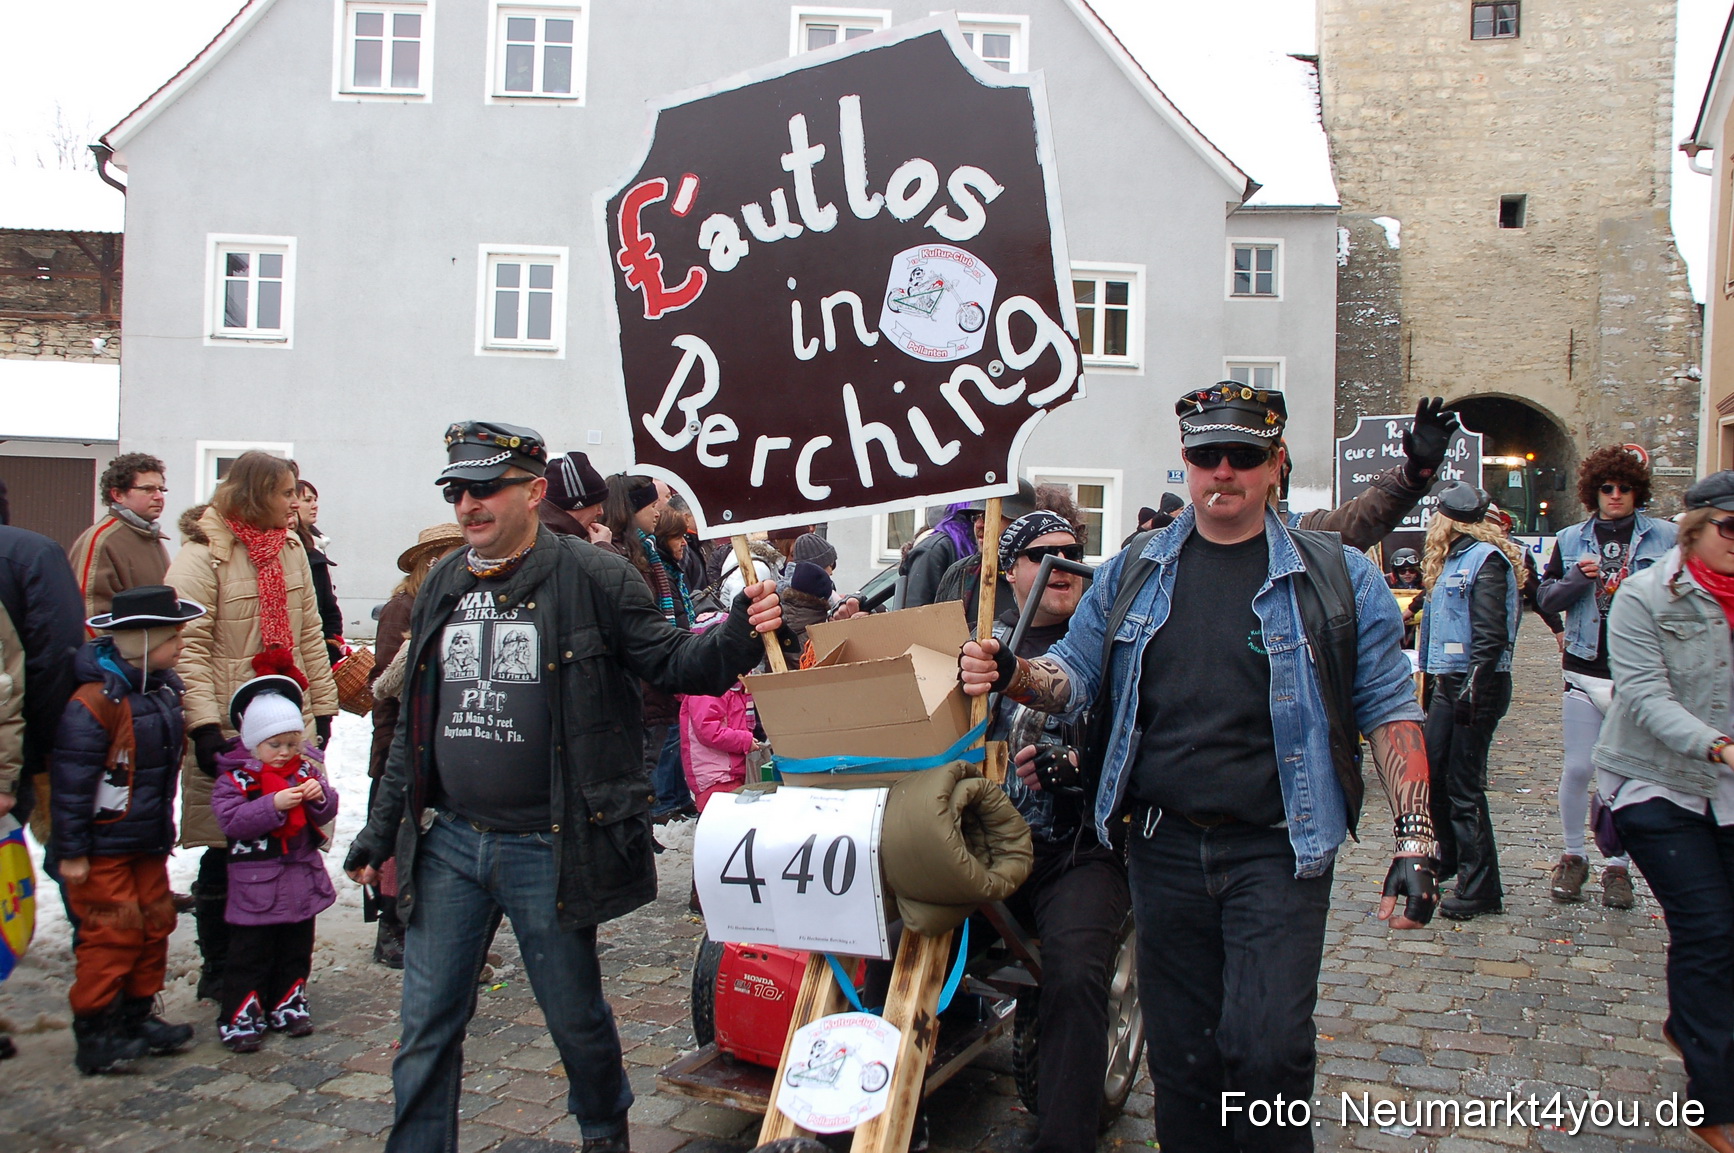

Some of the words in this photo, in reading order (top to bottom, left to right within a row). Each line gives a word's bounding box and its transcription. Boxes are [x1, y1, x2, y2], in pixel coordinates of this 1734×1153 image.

[786, 276, 879, 361] in
[907, 340, 948, 357] Pollanten
[642, 294, 1078, 500] Berching
[1344, 449, 1376, 461] eure
[1441, 461, 1465, 481] ihr
[477, 680, 492, 690] THE
[460, 687, 507, 713] PIT
[465, 712, 485, 725] Main
[507, 731, 525, 742] Fla.
[720, 828, 766, 904] 4
[781, 833, 856, 896] 40
[744, 973, 775, 986] HONDA
